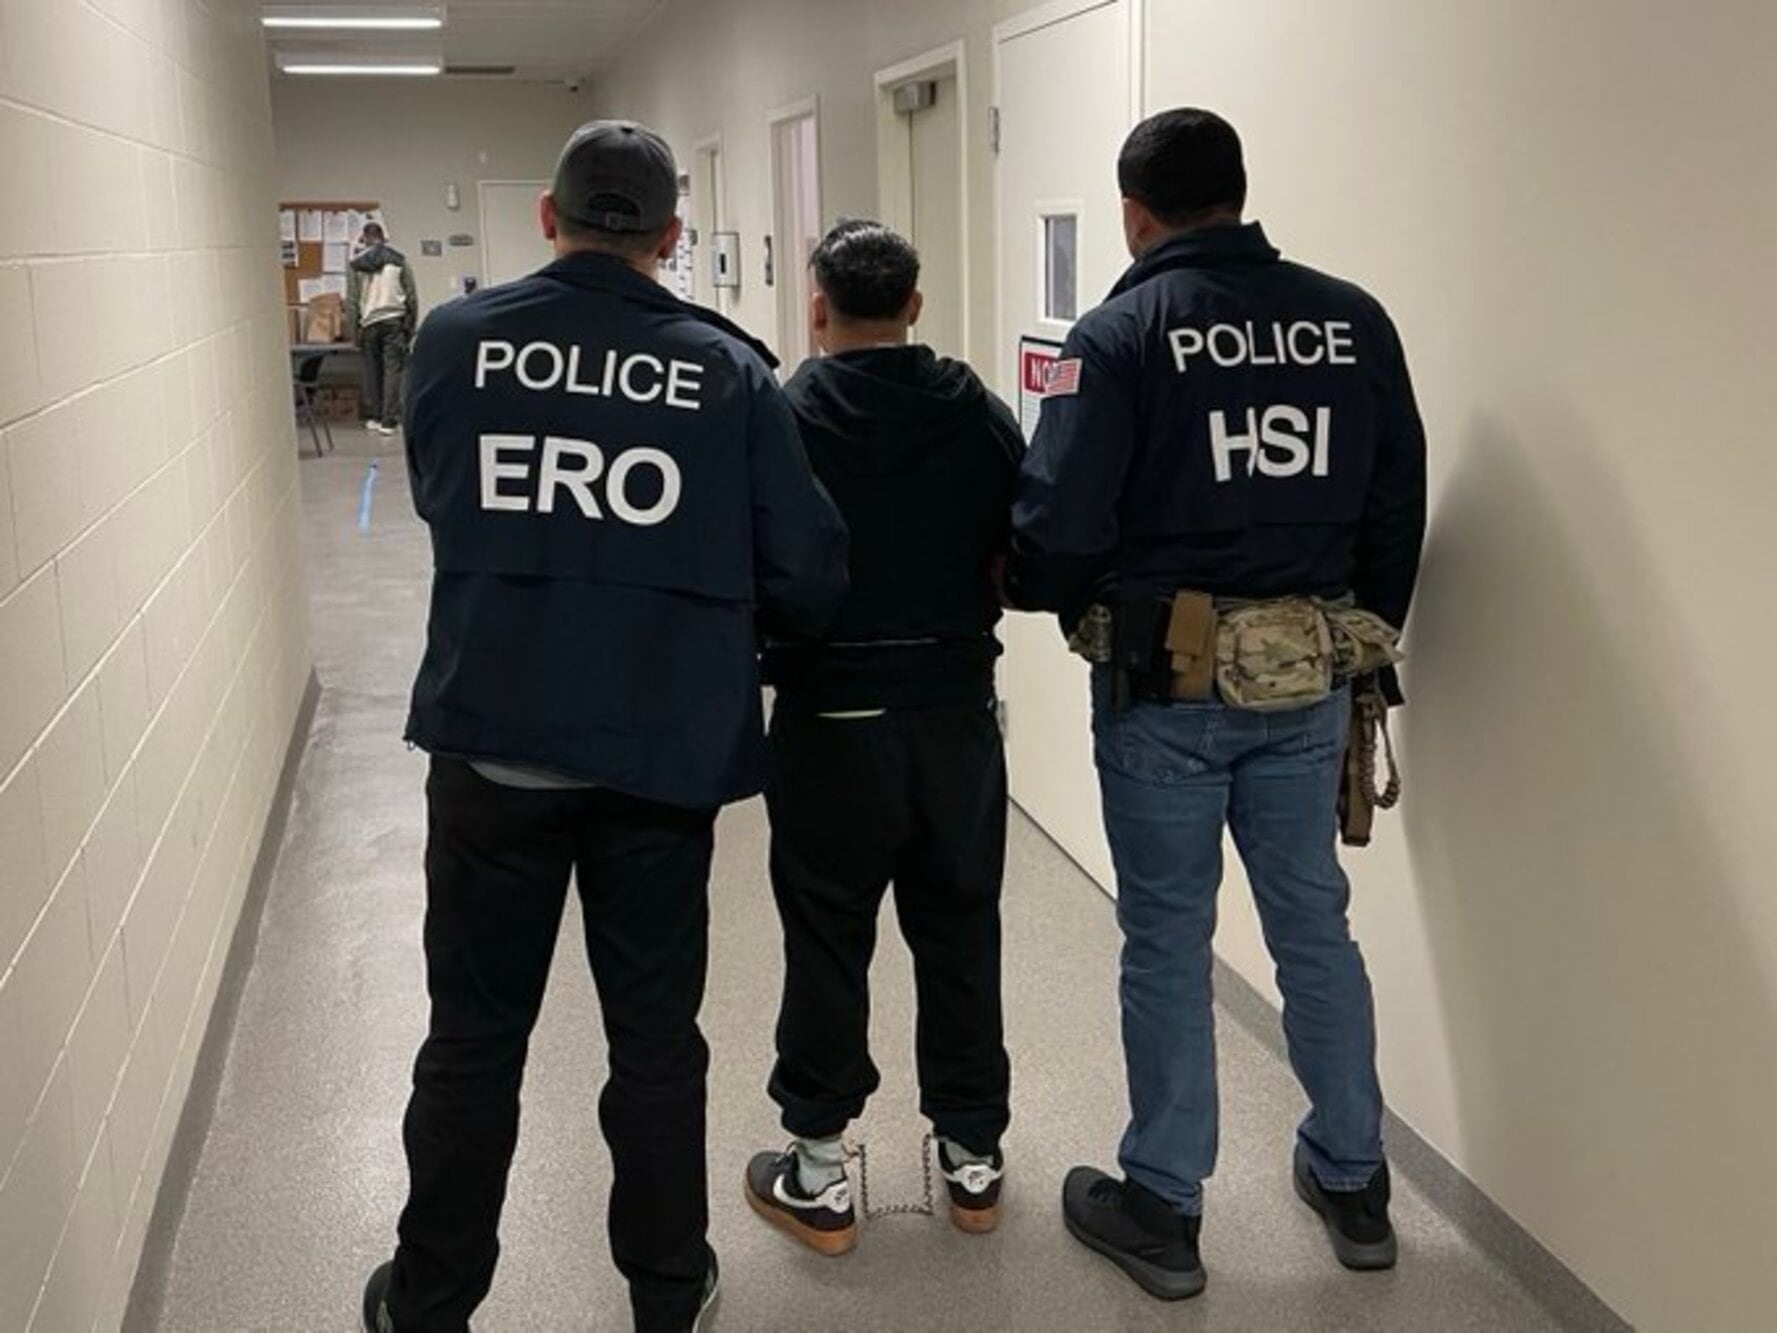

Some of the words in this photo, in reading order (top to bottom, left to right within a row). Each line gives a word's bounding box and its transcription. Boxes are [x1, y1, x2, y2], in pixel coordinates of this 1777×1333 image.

[475, 340, 704, 410] POLICE
[1168, 320, 1356, 373] POLICE
[1209, 404, 1331, 482] HSI
[479, 435, 682, 526] ERO
